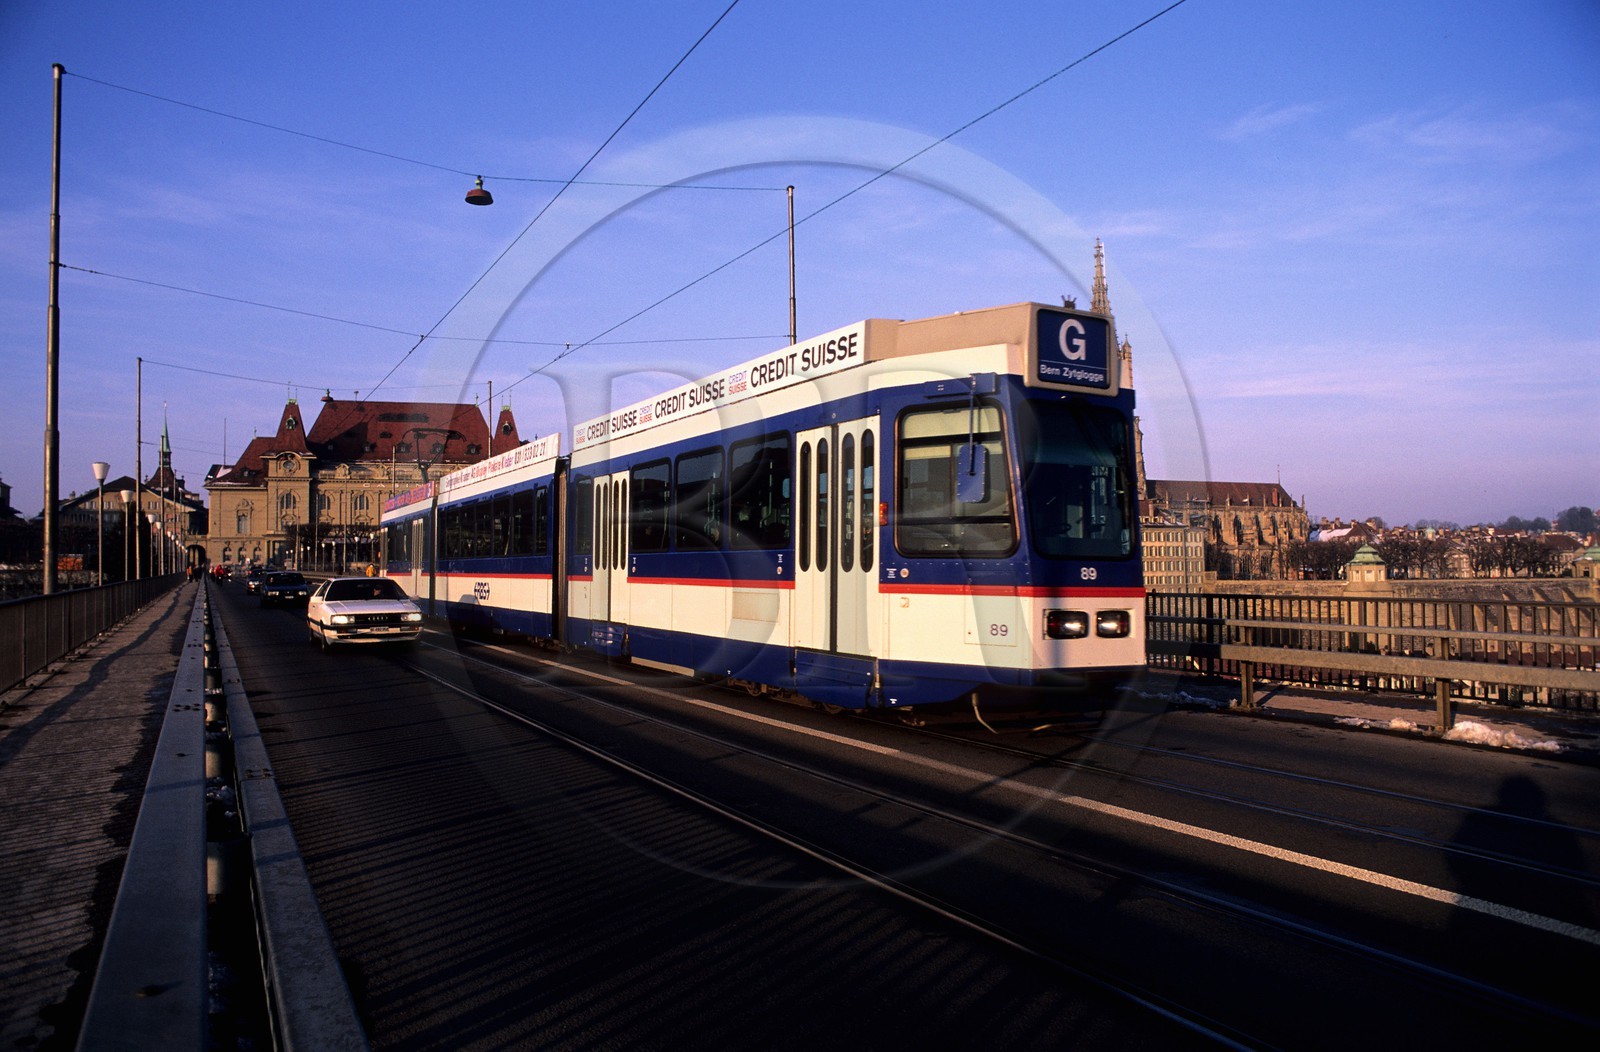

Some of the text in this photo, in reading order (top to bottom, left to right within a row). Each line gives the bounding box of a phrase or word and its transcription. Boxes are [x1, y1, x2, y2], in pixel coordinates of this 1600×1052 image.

[1059, 318, 1086, 361] G
[750, 332, 858, 388] CREDIT SUISSE
[728, 370, 747, 385] CREDIT
[1040, 364, 1104, 382] Bern Zytglogge
[728, 381, 747, 396] SUISSE
[654, 378, 725, 419] CREDIT SUISSE
[586, 409, 638, 441] CREDIT SUISSE
[639, 413, 653, 425] SUISSE
[1080, 567, 1097, 580] 89
[990, 623, 1008, 637] 89
